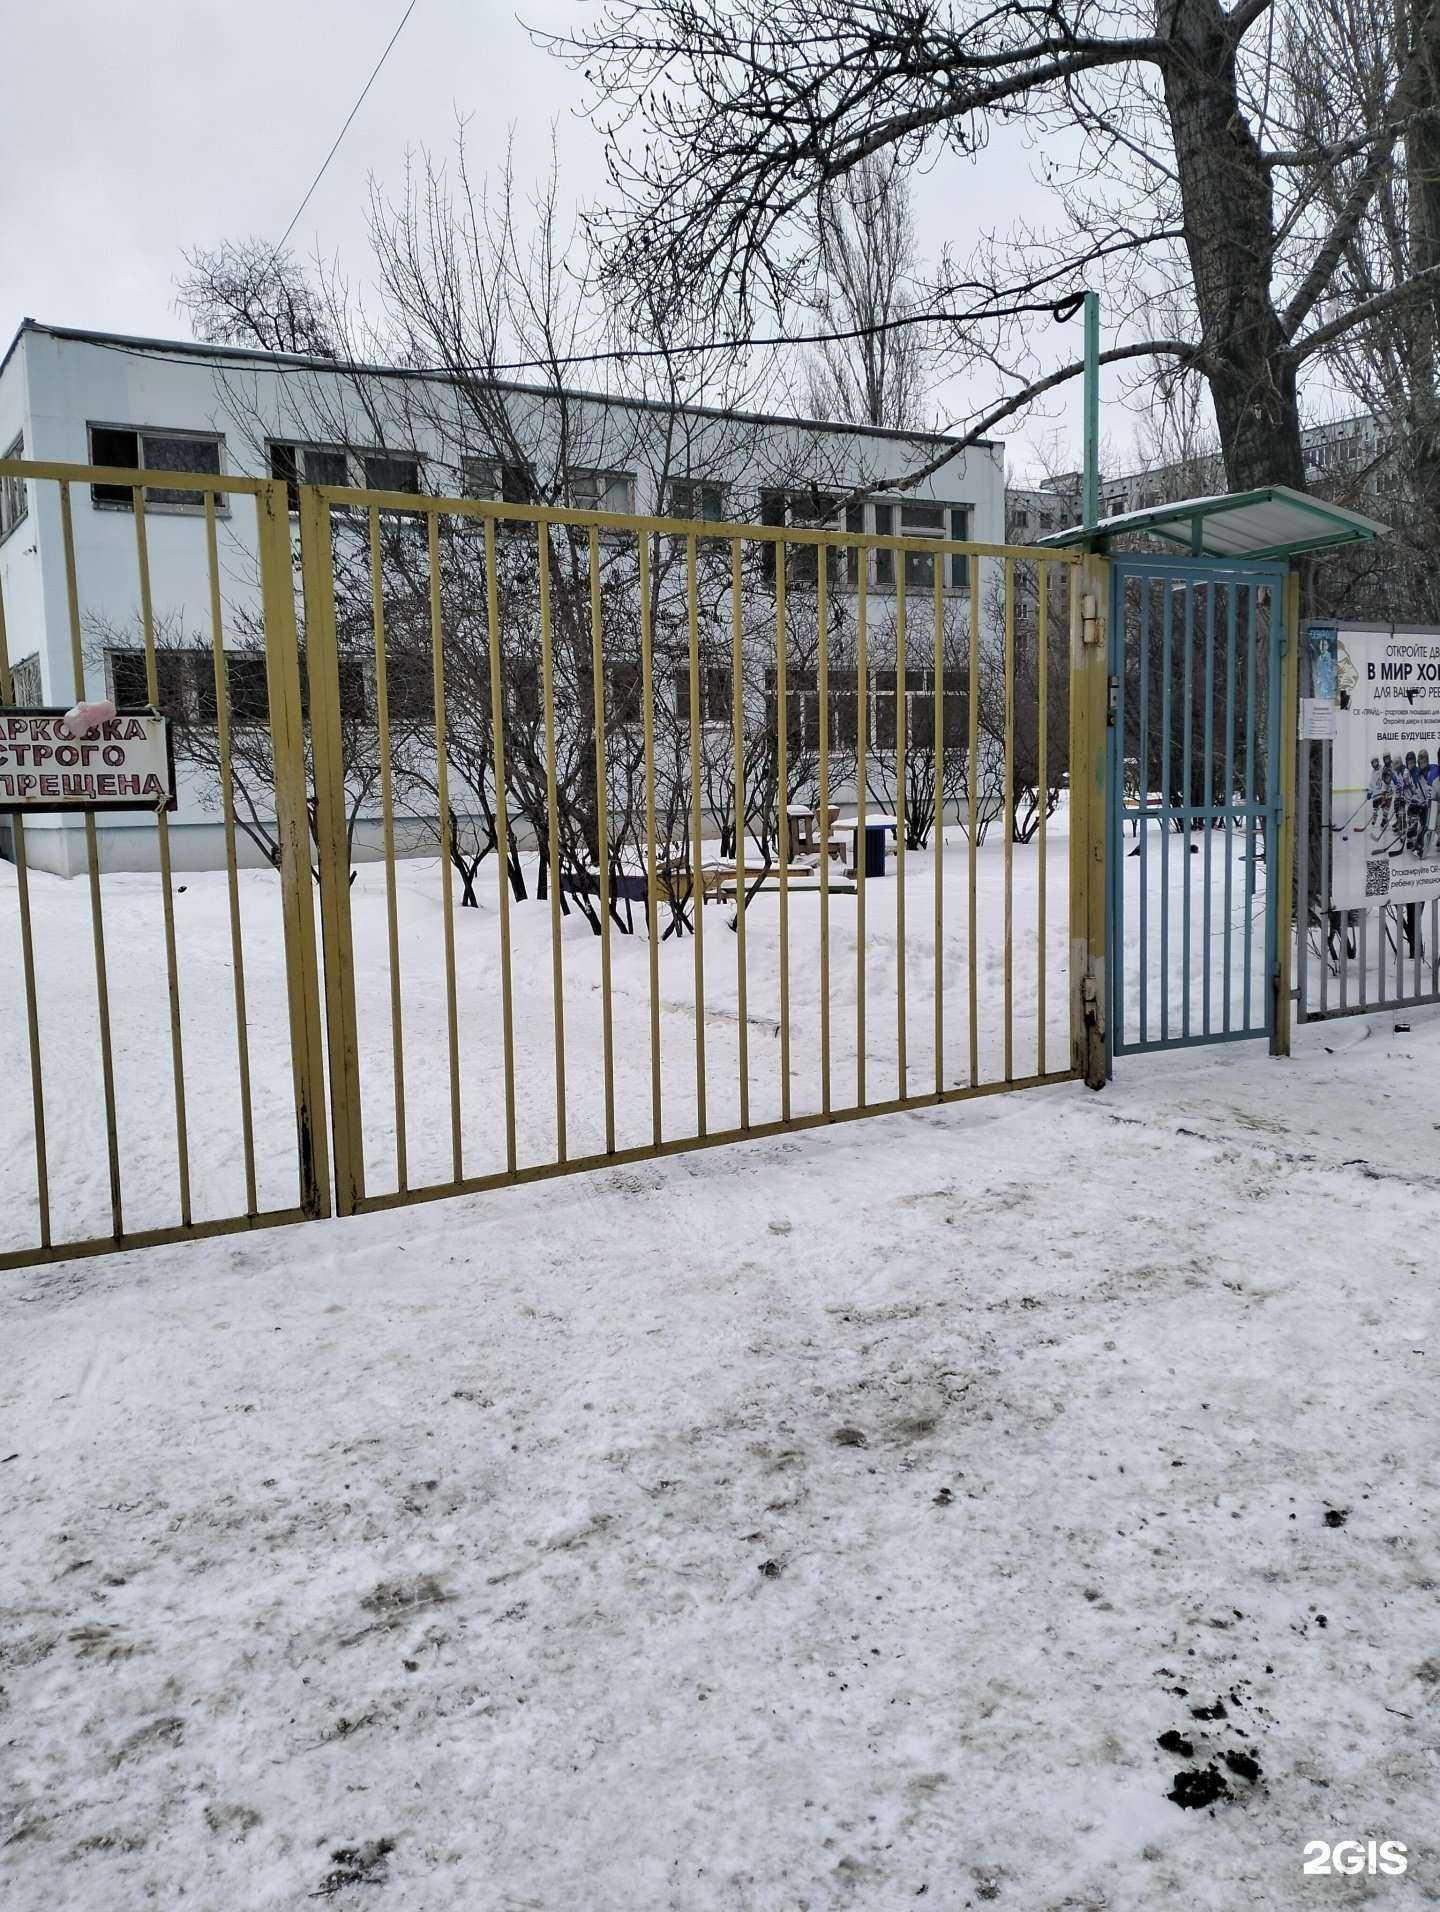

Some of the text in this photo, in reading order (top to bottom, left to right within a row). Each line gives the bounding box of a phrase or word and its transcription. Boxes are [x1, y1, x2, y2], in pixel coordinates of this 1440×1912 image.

[1386, 643, 1427, 658] ОТКРОЙТЕ
[1367, 662, 1440, 681] В МИР ХО
[1373, 686, 1391, 699] ДЛЯ
[0, 719, 147, 741] РКОВКА
[1377, 732, 1399, 741] ВАШЕ
[1401, 731, 1436, 741] БУДУЩЕЕ
